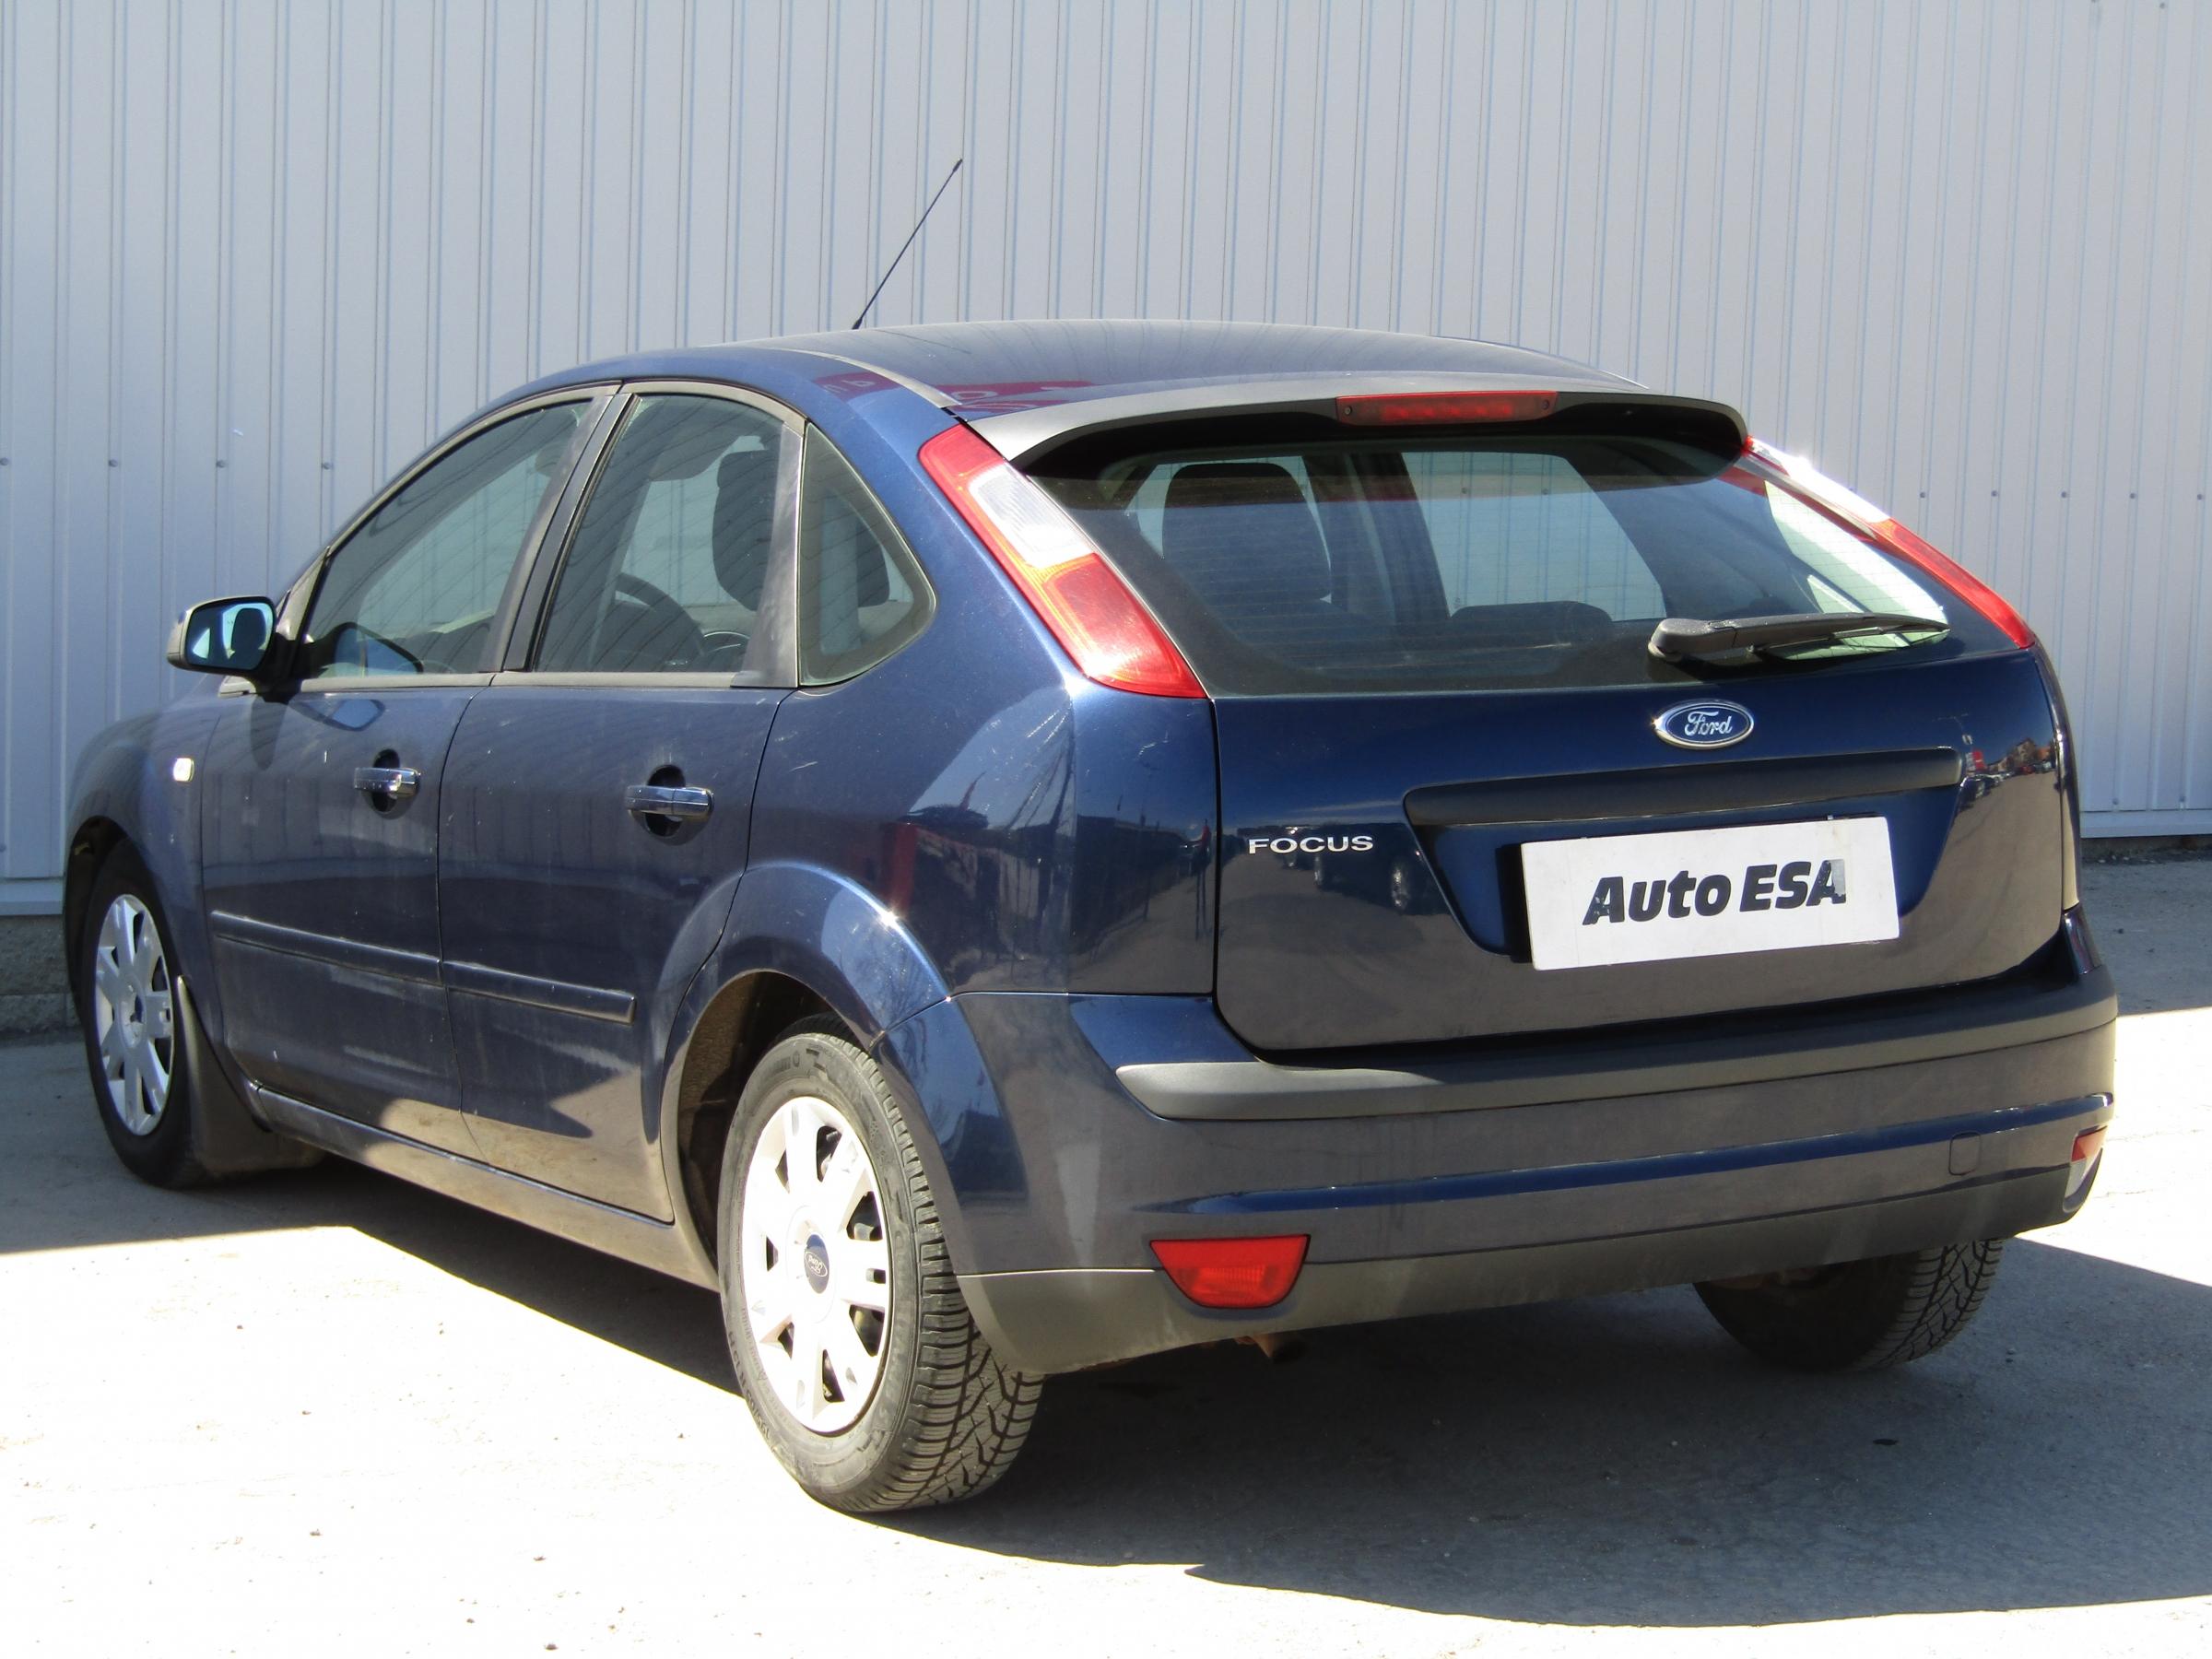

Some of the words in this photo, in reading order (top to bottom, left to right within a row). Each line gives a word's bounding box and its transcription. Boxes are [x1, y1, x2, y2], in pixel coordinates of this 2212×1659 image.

[1684, 711, 1733, 736] Ford
[1248, 835, 1374, 854] FOCUS
[1582, 870, 1732, 925] Auto
[1739, 859, 1847, 912] ESA
